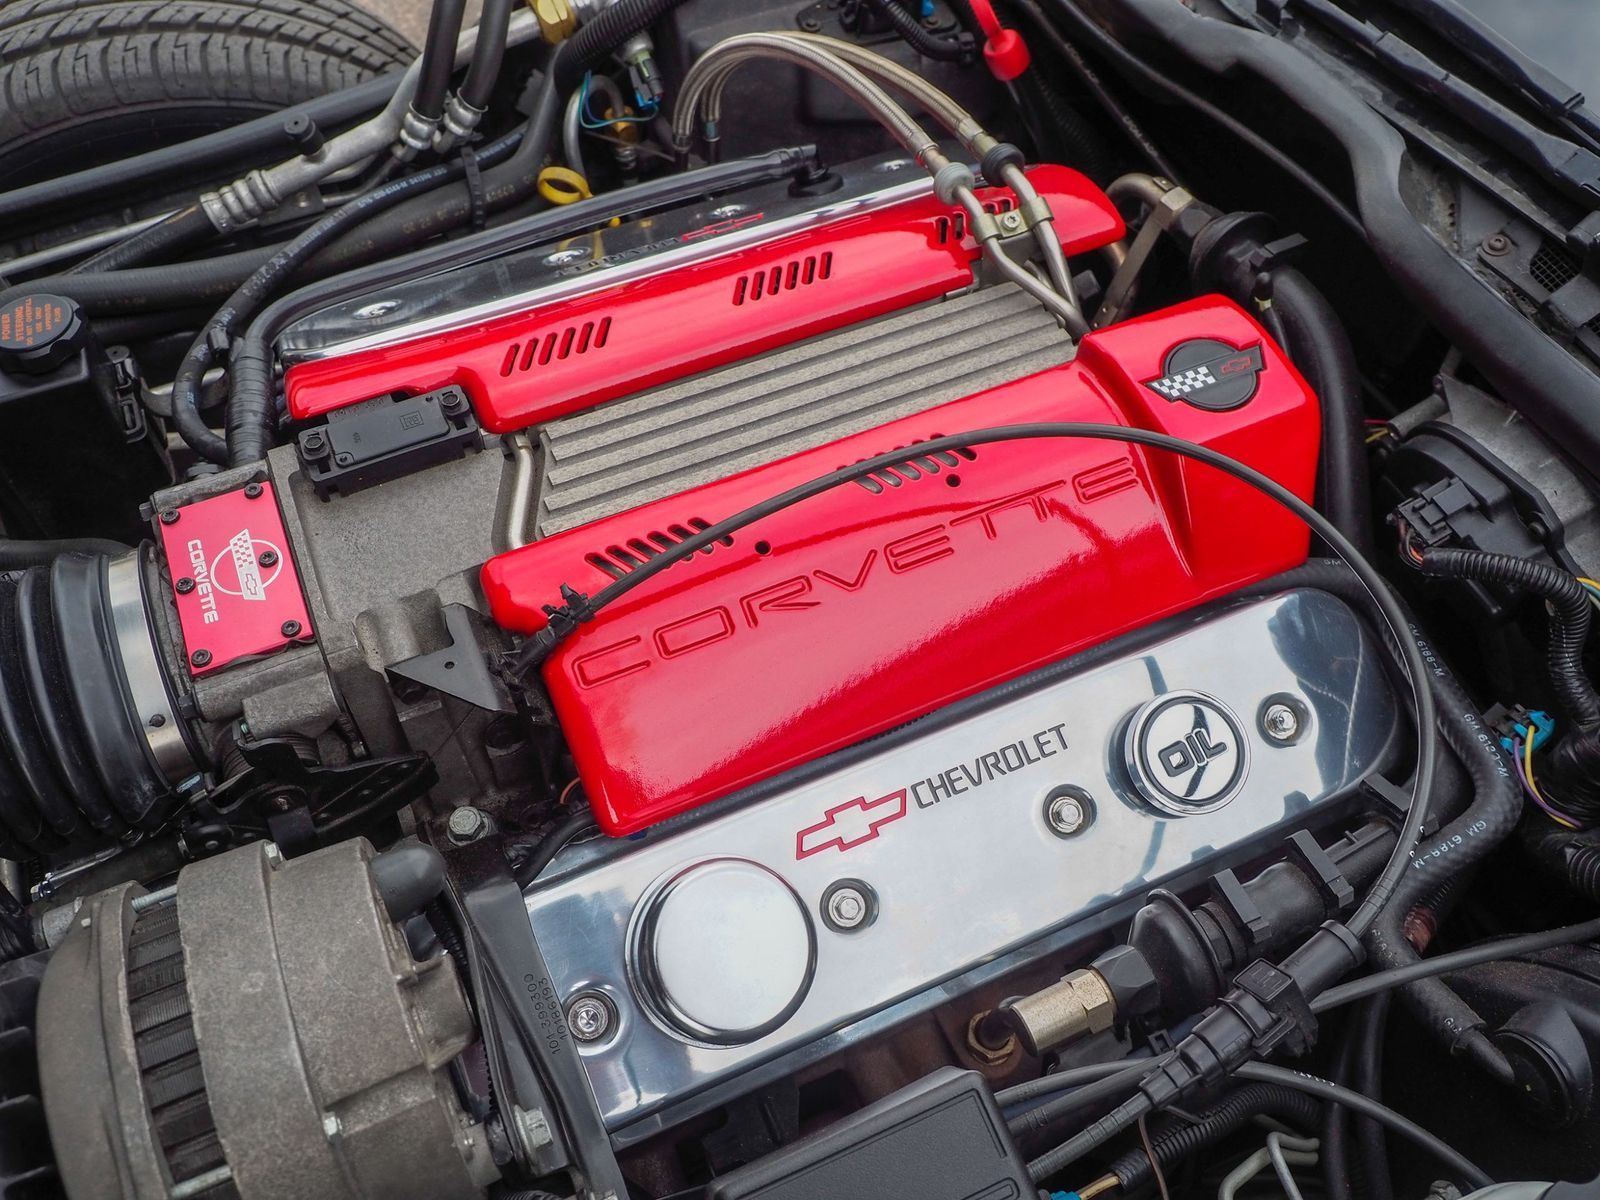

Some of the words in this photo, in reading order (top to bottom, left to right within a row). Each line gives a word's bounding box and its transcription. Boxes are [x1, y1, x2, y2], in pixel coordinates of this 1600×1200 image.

[1, 312, 11, 341] POWER
[15, 305, 24, 342] STEERING
[187, 538, 221, 625] CORVETTE
[571, 455, 1140, 690] CORVETTE
[911, 722, 1073, 810] CHEVROLET
[1158, 728, 1228, 778] OIL
[1465, 820, 1487, 838] GM
[524, 974, 560, 1054] 101-399300
[538, 977, 569, 1040] 10186193
